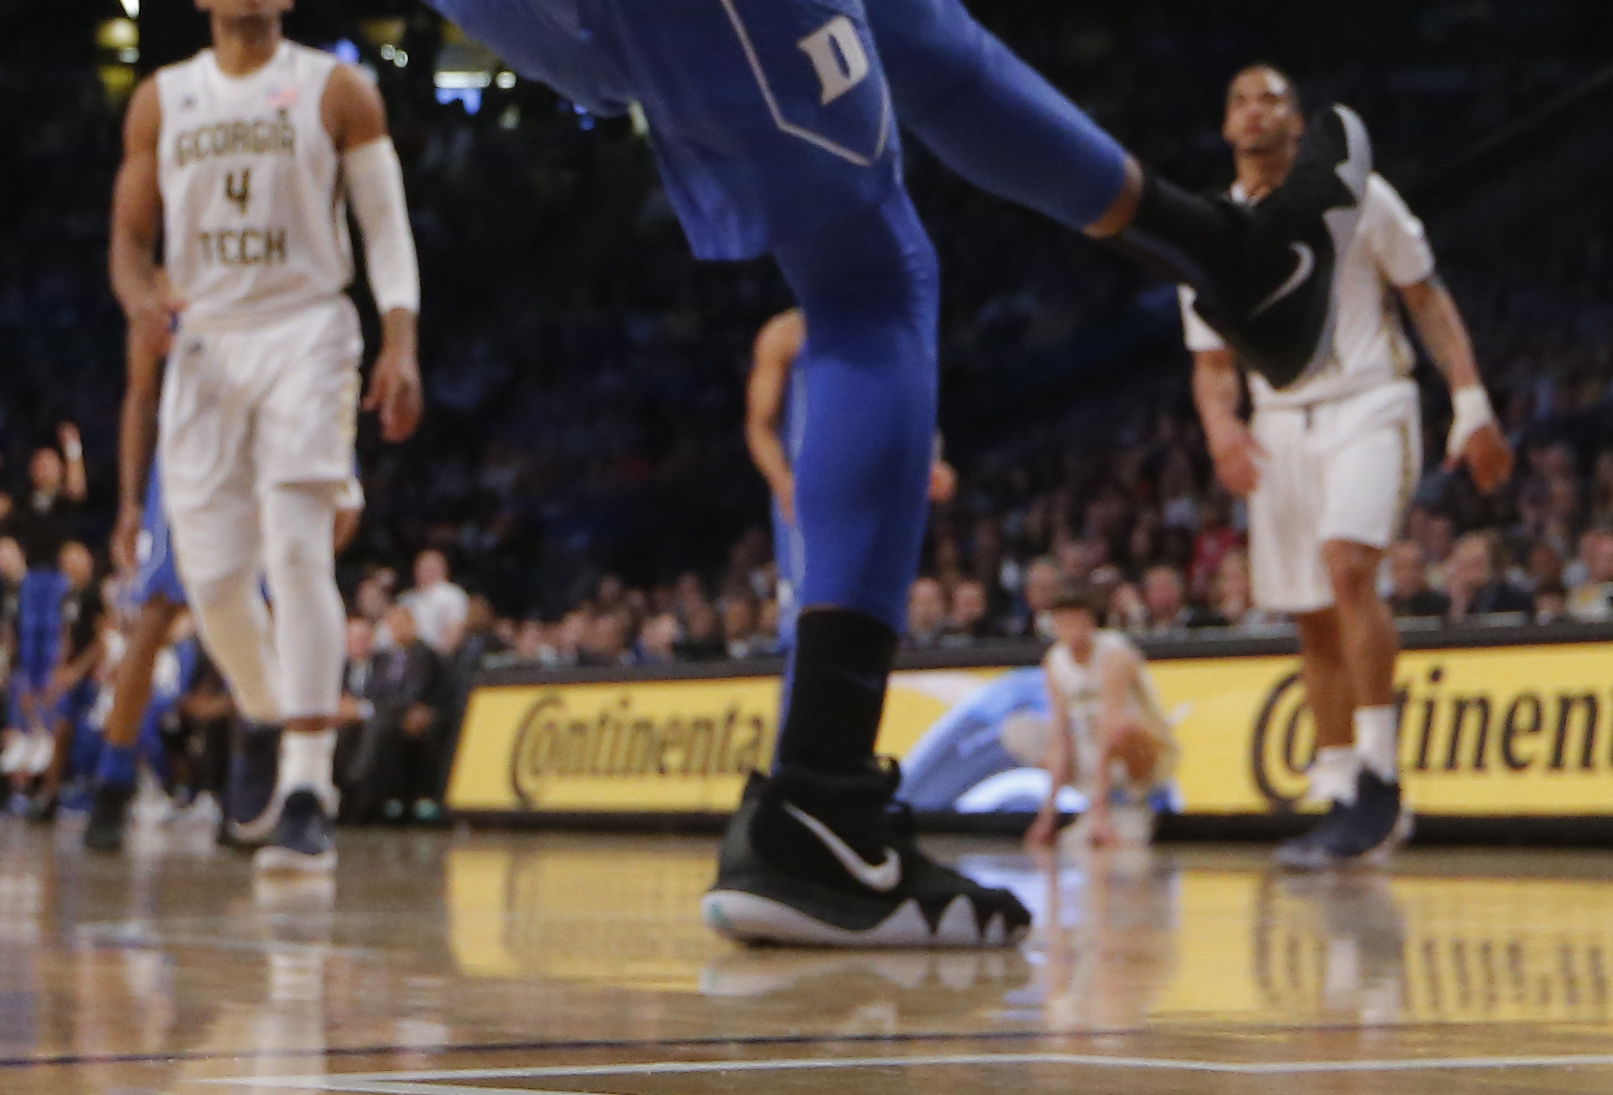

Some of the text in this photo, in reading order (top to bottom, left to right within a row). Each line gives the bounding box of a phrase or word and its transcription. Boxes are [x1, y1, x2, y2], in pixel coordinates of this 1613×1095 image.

[796, 13, 868, 106] D
[225, 168, 252, 217] 4
[197, 228, 286, 266] TECH
